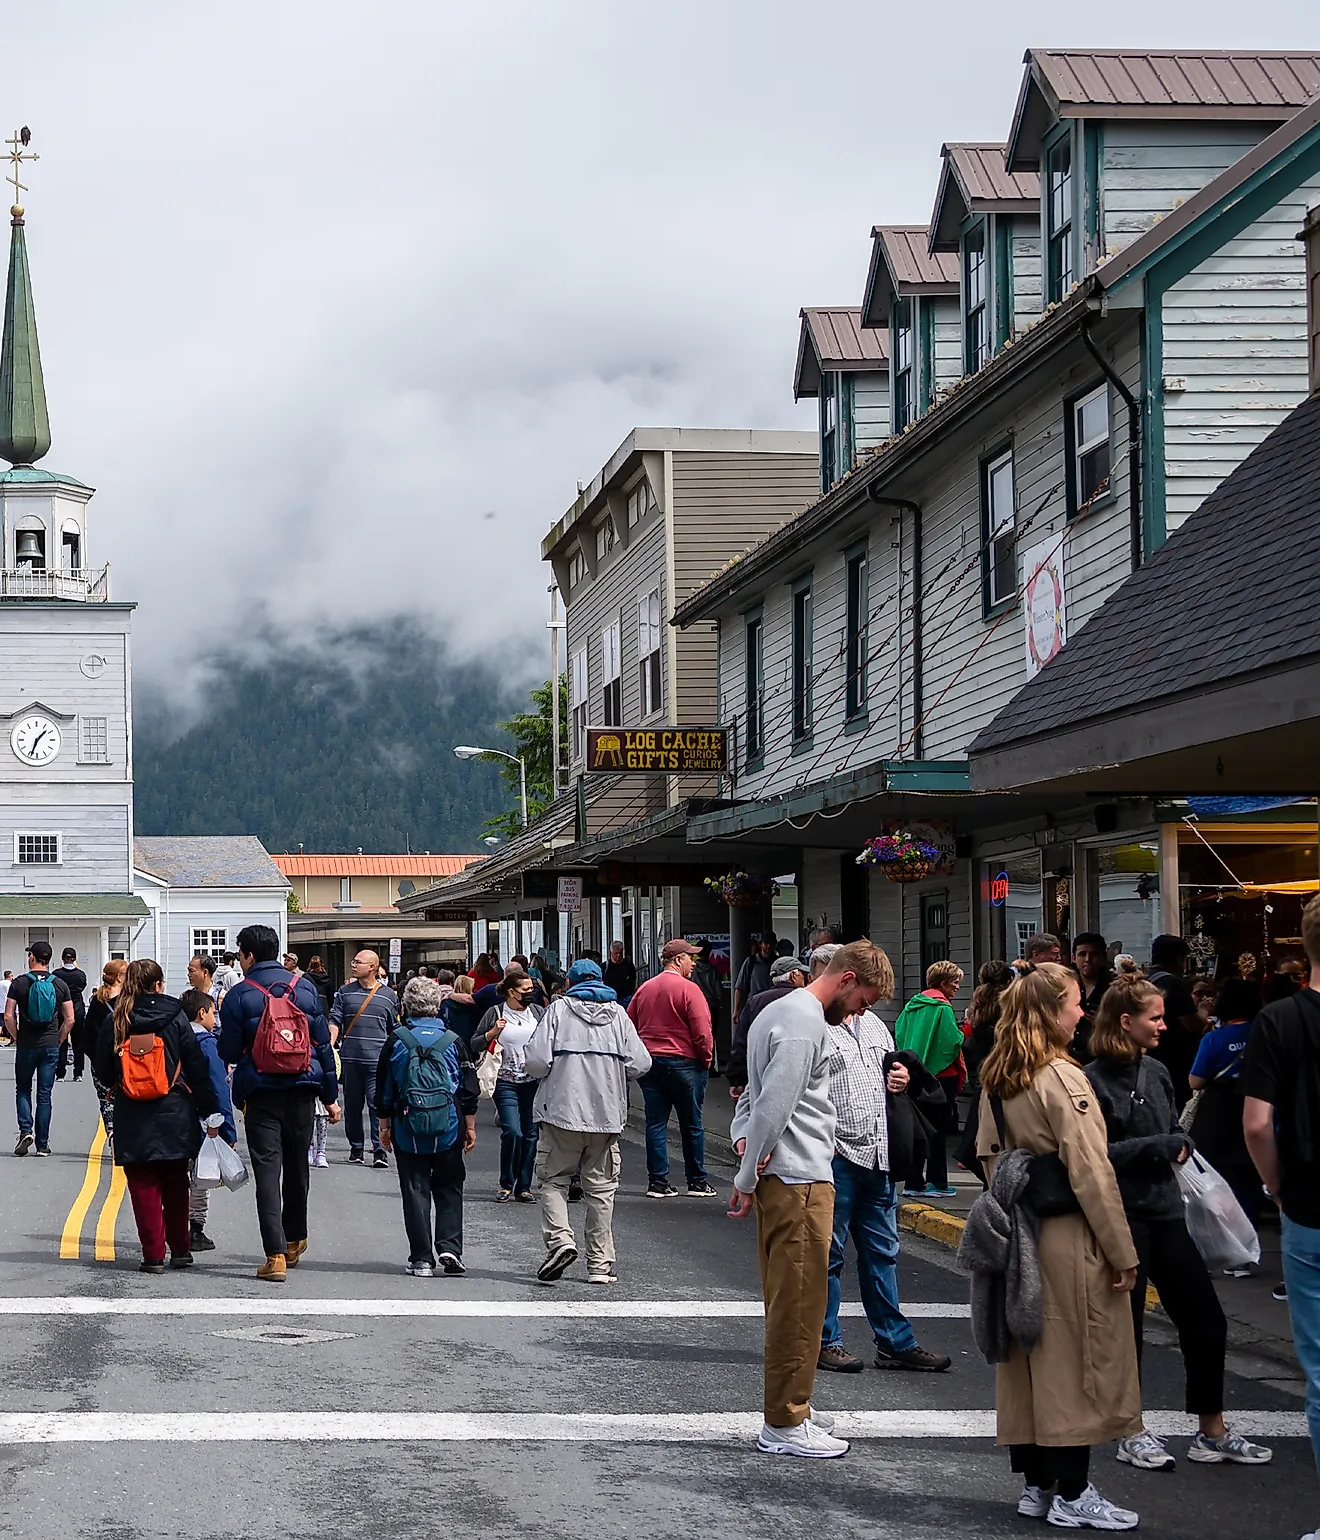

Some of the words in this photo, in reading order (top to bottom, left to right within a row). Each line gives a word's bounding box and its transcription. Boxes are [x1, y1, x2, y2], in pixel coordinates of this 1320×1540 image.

[625, 732, 656, 749] LOG
[662, 732, 722, 750] CACHE
[627, 751, 679, 769] GIFTS
[683, 750, 718, 759] CURIOS
[683, 759, 722, 769] JEWELRY
